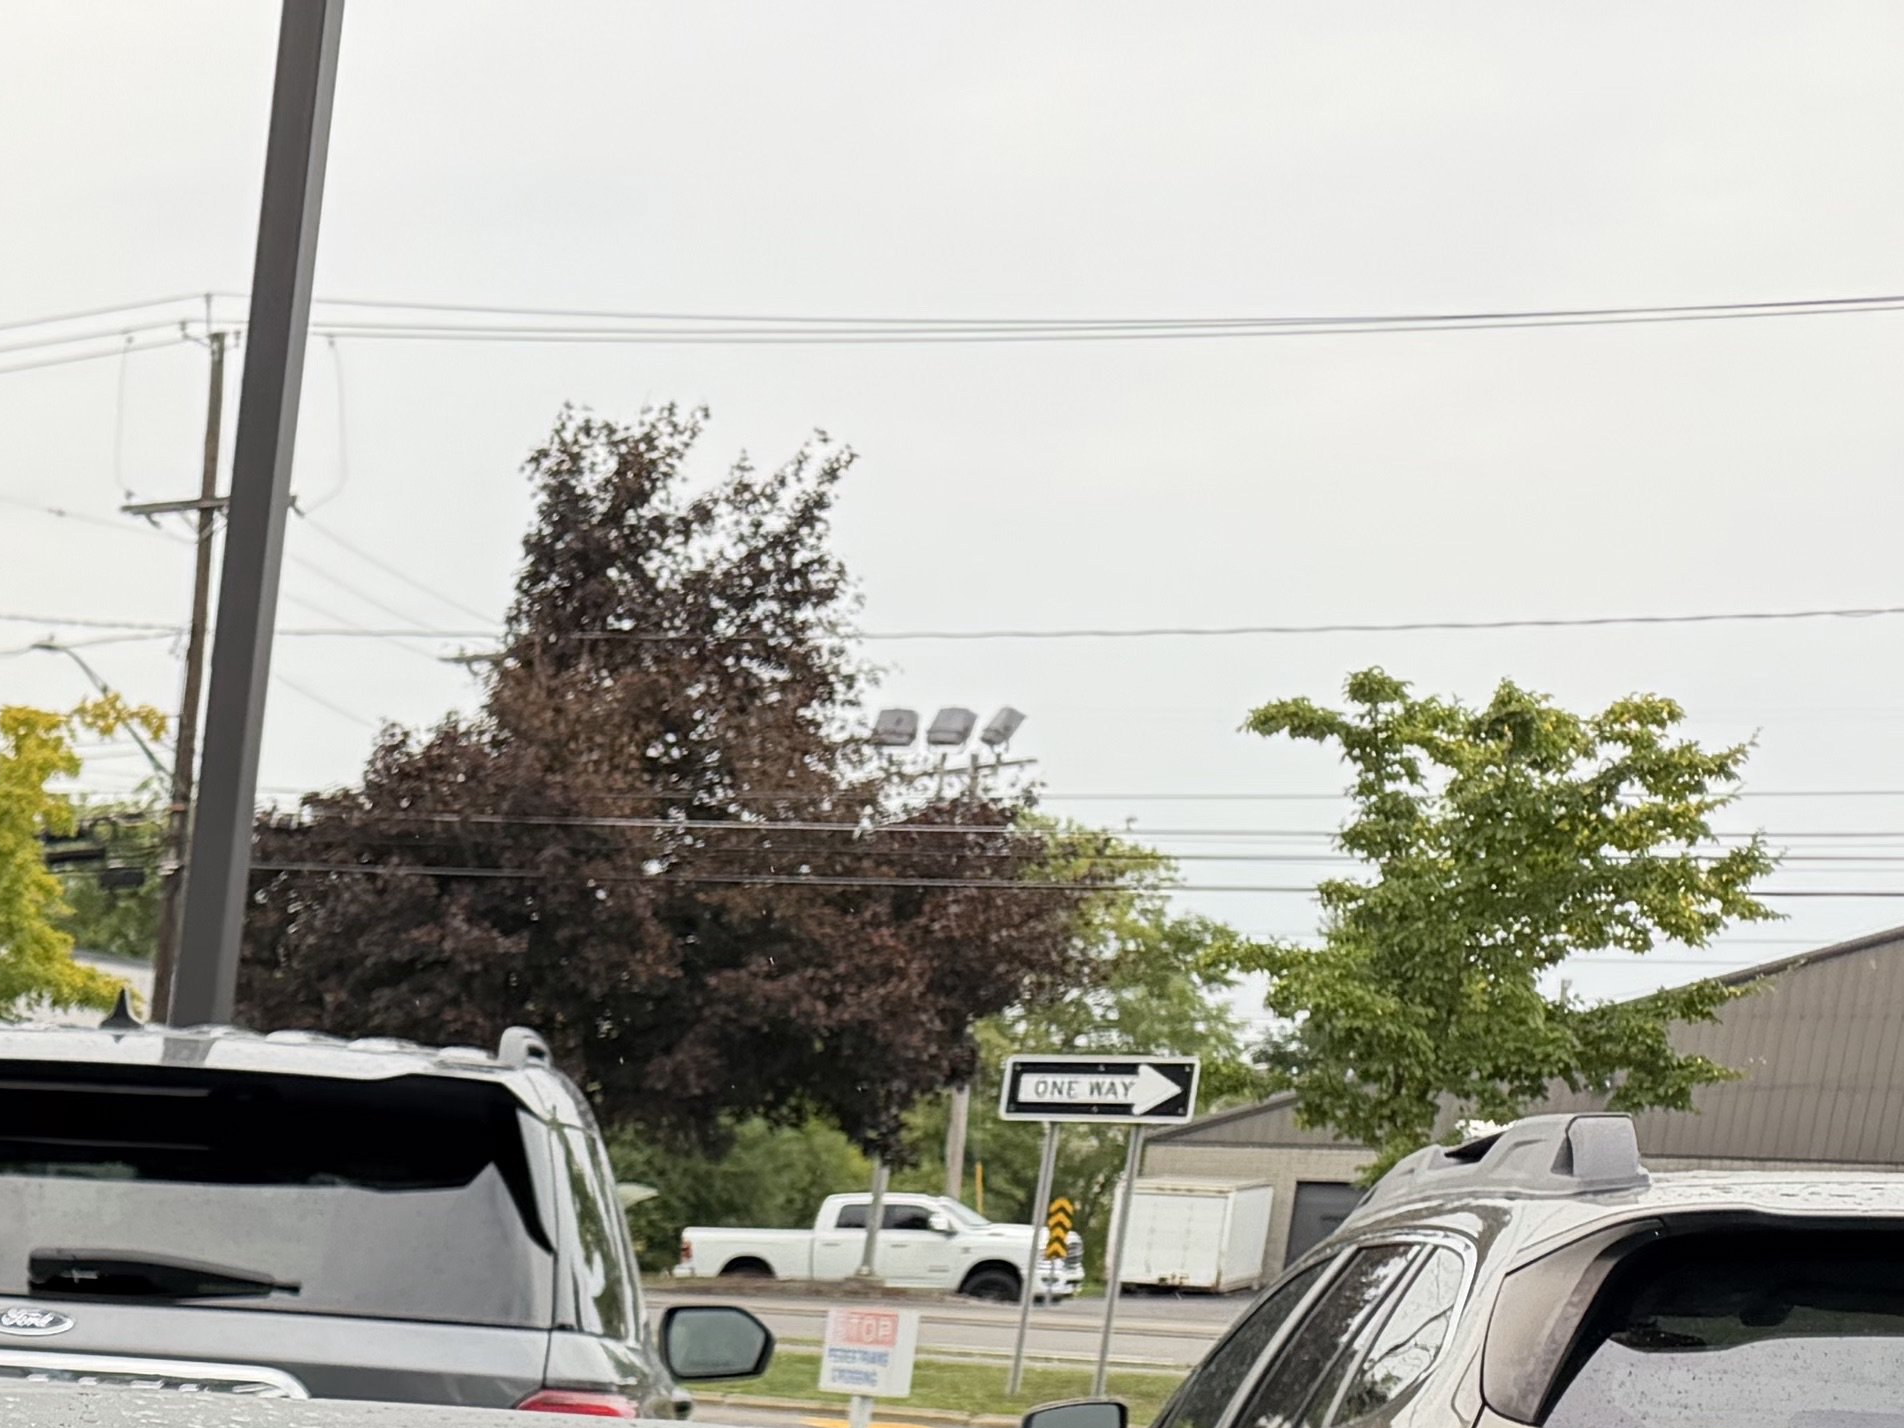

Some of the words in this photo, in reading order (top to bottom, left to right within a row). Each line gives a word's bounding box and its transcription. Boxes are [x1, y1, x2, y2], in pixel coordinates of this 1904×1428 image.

[1034, 1080, 1079, 1099] ONE
[1089, 1080, 1135, 1099] WAY
[1, 1308, 55, 1328] Ford
